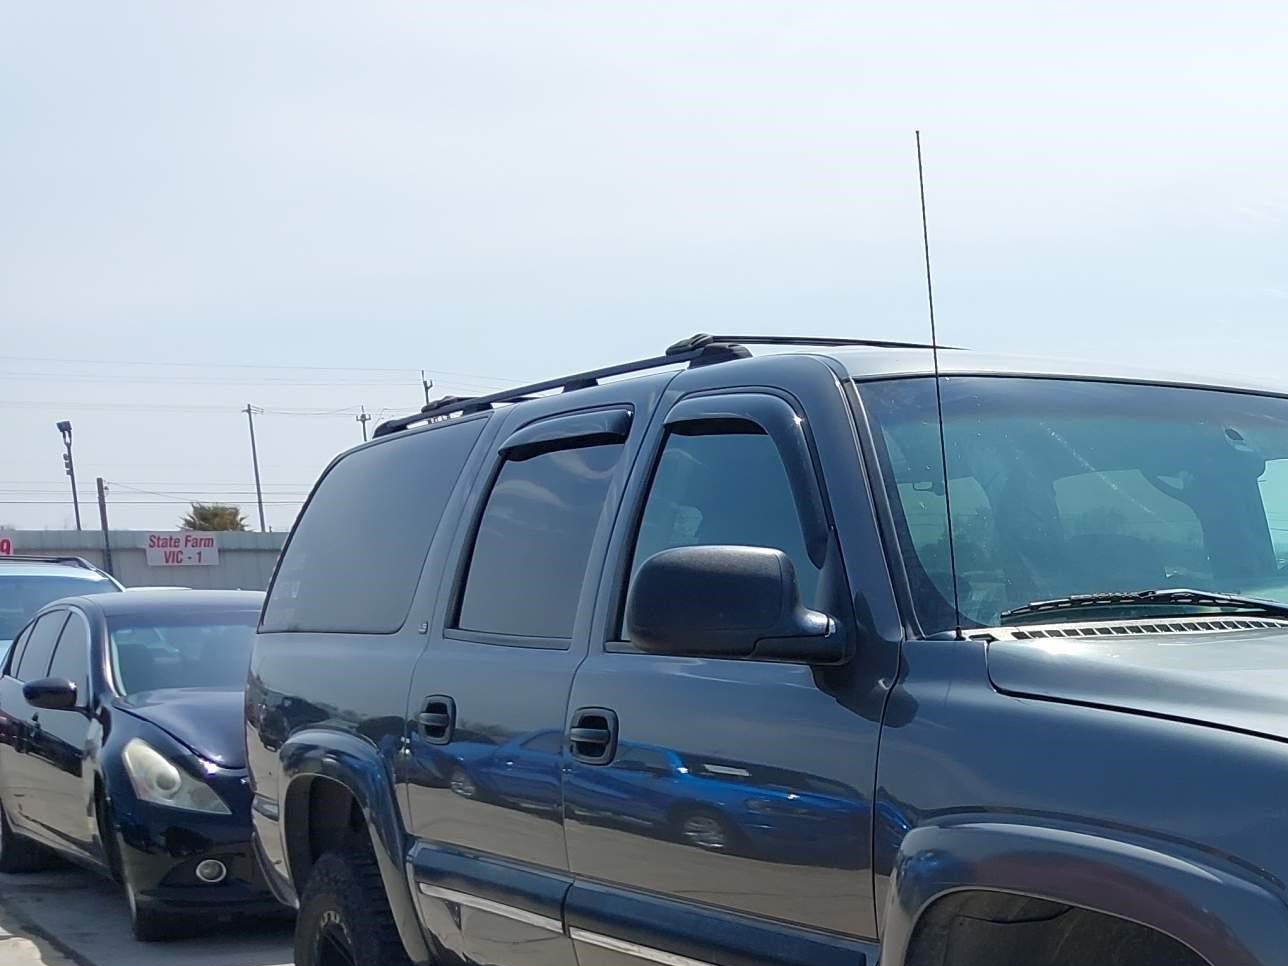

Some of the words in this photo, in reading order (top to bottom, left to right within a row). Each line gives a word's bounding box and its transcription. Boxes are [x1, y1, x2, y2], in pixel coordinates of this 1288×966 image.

[149, 534, 181, 549] State
[184, 534, 214, 549] Farm
[164, 550, 184, 564] VIC
